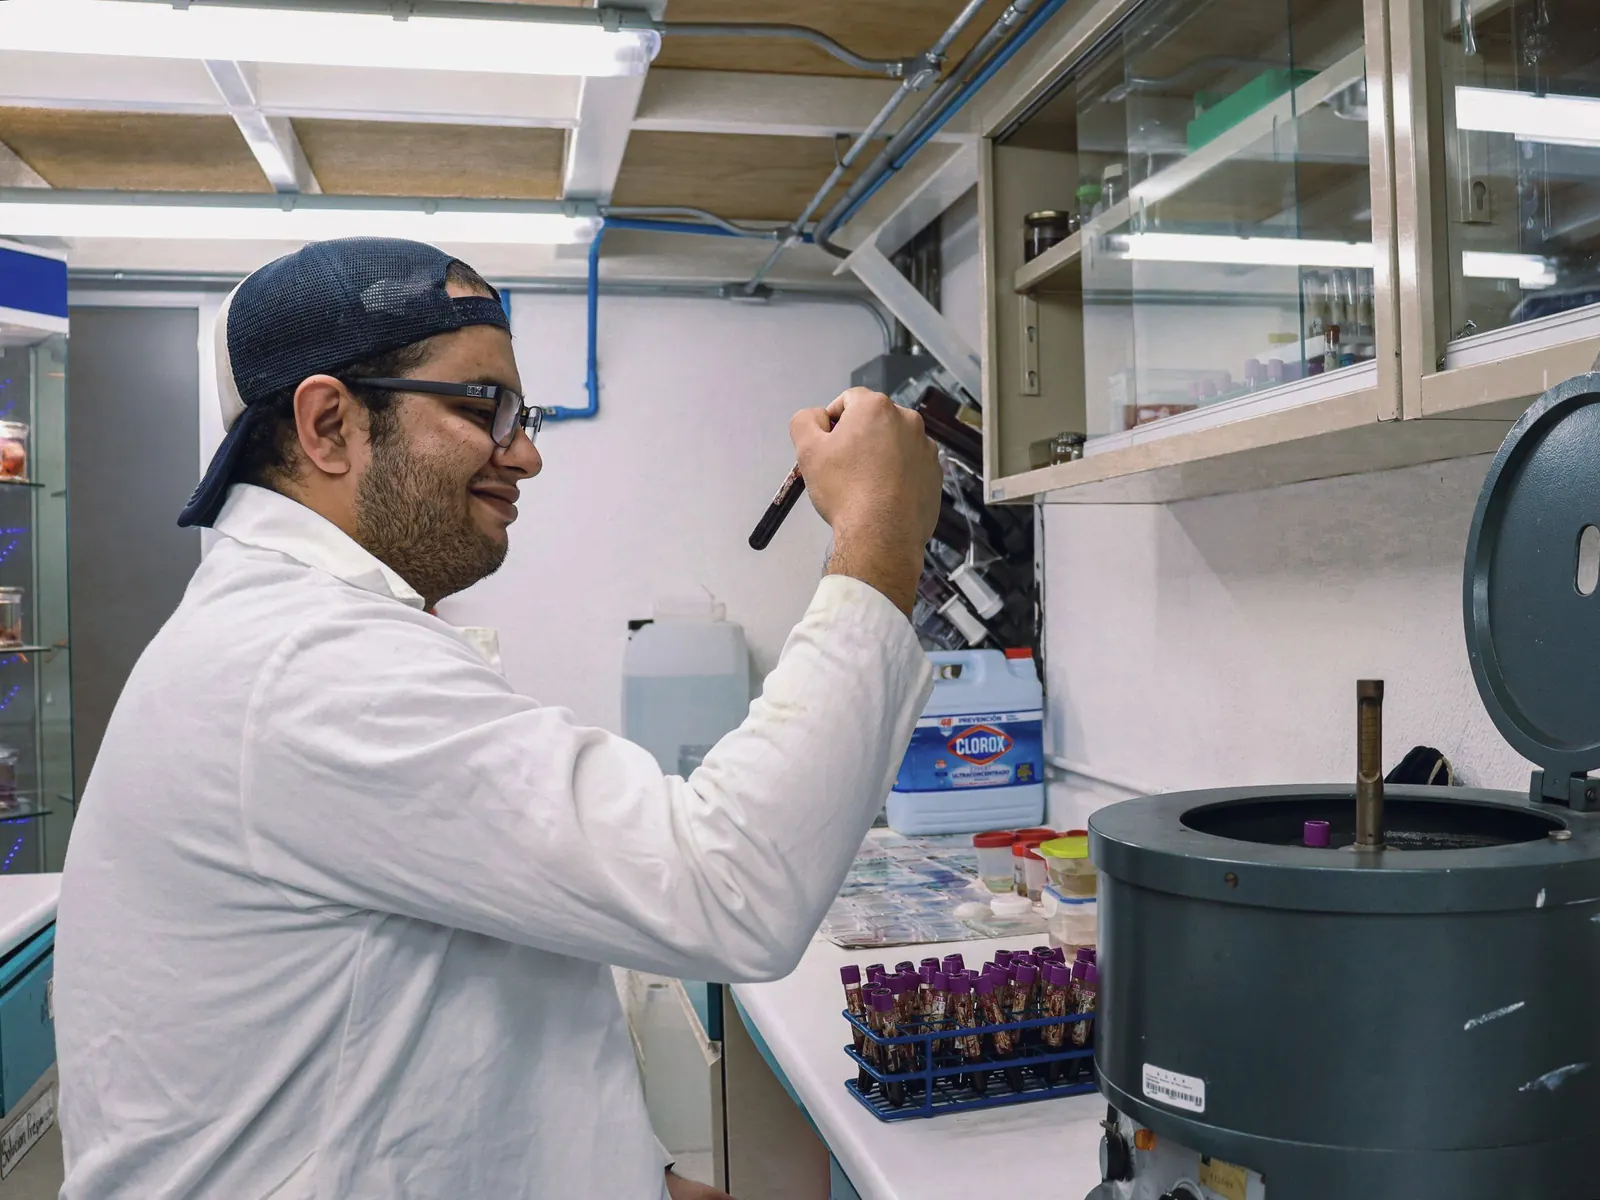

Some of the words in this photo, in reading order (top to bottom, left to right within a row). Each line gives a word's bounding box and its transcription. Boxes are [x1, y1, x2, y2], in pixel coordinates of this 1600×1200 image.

[958, 714, 1002, 724] PREVENCIÓN
[955, 735, 1005, 755] CLOROX
[951, 769, 1010, 778] ULTRACONCENTRADO
